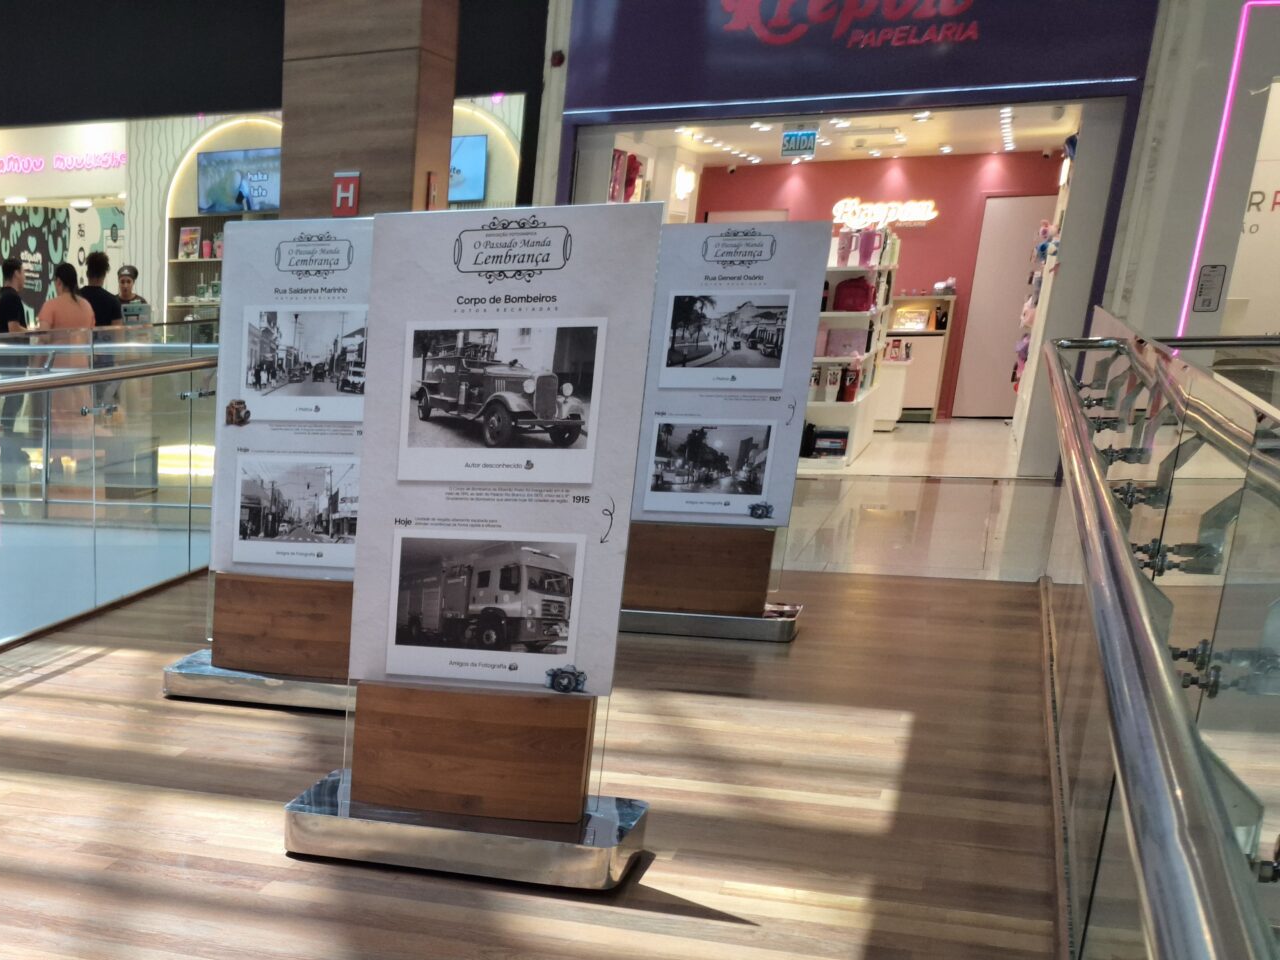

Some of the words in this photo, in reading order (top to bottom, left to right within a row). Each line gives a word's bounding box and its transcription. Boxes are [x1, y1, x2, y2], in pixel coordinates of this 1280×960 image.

[847, 21, 979, 48] PAPELARIA
[782, 135, 815, 150] SAÍDA
[335, 183, 355, 209] H
[473, 240, 482, 249] O
[482, 239, 518, 249] Passado
[519, 237, 552, 249] Manda
[472, 249, 552, 267] Lembrança
[320, 286, 348, 294] Marinho
[456, 296, 487, 307] Corpo
[488, 295, 502, 304] de
[504, 293, 558, 304] Bombeiros
[464, 461, 481, 469] Autor
[481, 461, 523, 470] desconhecido
[572, 495, 590, 504] 1915
[394, 517, 413, 526] Hoje
